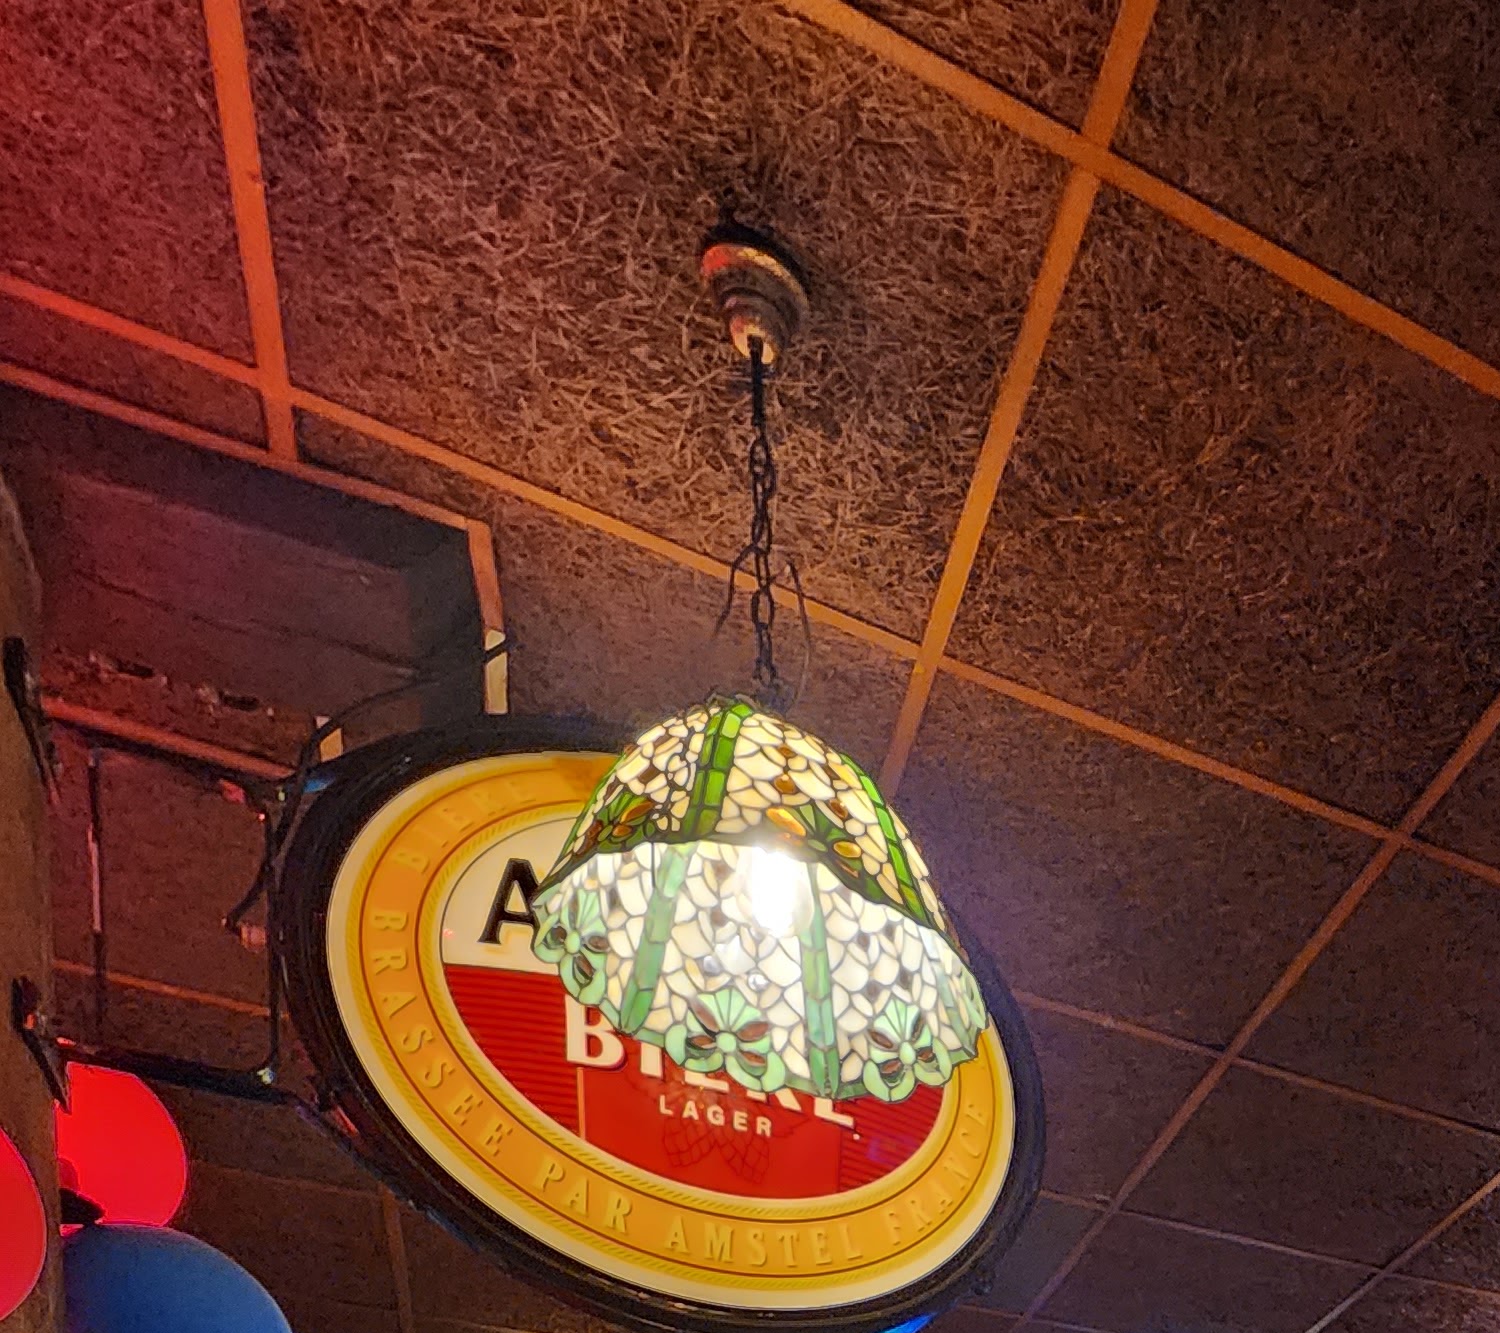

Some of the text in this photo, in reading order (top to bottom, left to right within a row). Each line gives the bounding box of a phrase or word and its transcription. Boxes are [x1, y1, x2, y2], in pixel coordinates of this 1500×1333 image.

[658, 1094, 773, 1138] LAGER
[532, 1157, 633, 1235] PAR
[664, 1214, 863, 1269] AMSTEL
[883, 1103, 990, 1247] FRANCE
